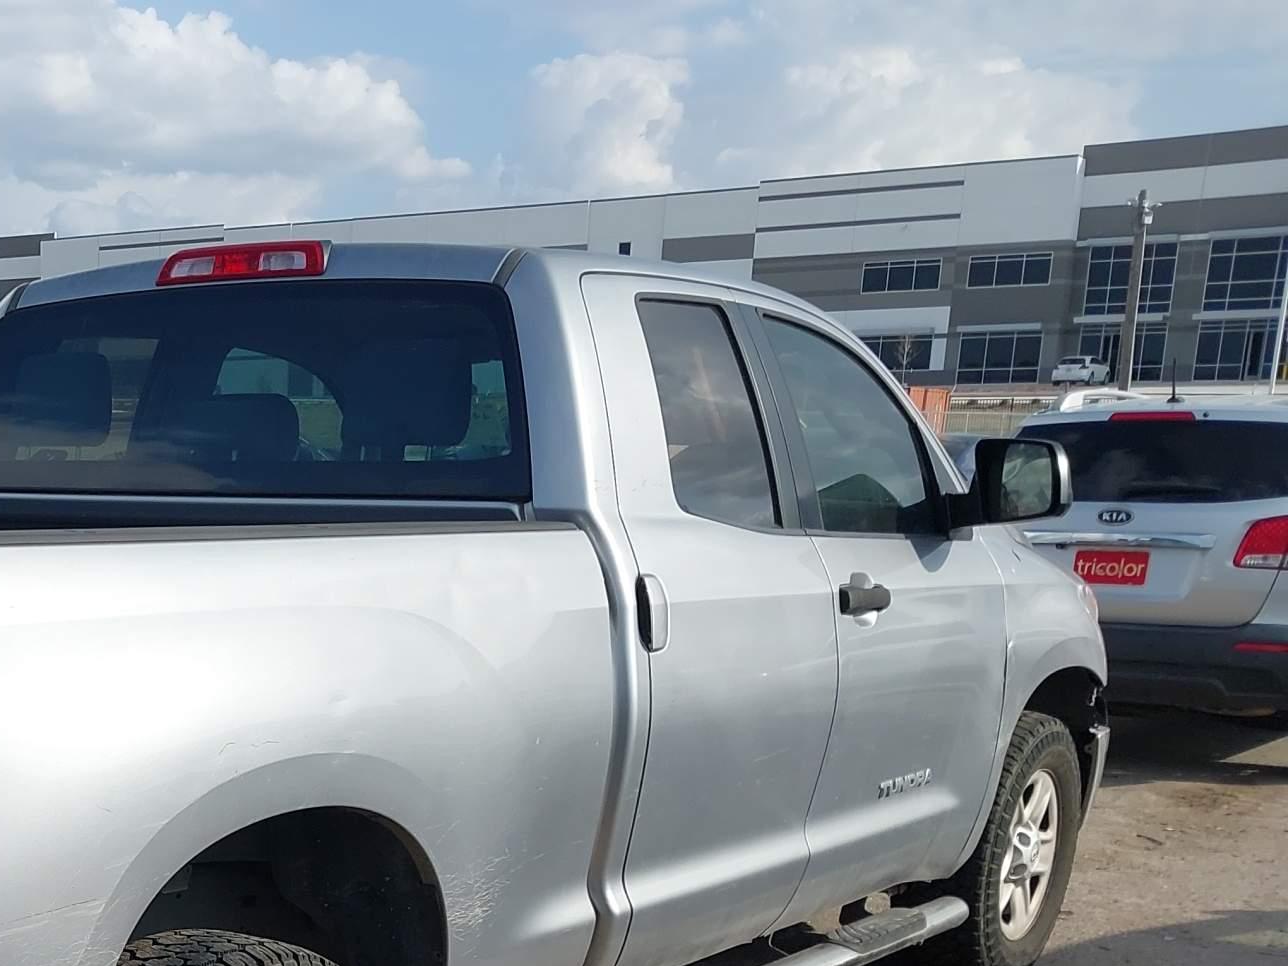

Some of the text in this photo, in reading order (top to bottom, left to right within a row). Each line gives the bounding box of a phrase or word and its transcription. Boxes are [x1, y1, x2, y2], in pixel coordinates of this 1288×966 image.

[1101, 511, 1128, 521] KIA
[1076, 557, 1146, 579] tricolor
[877, 767, 931, 800] TUNDRA
